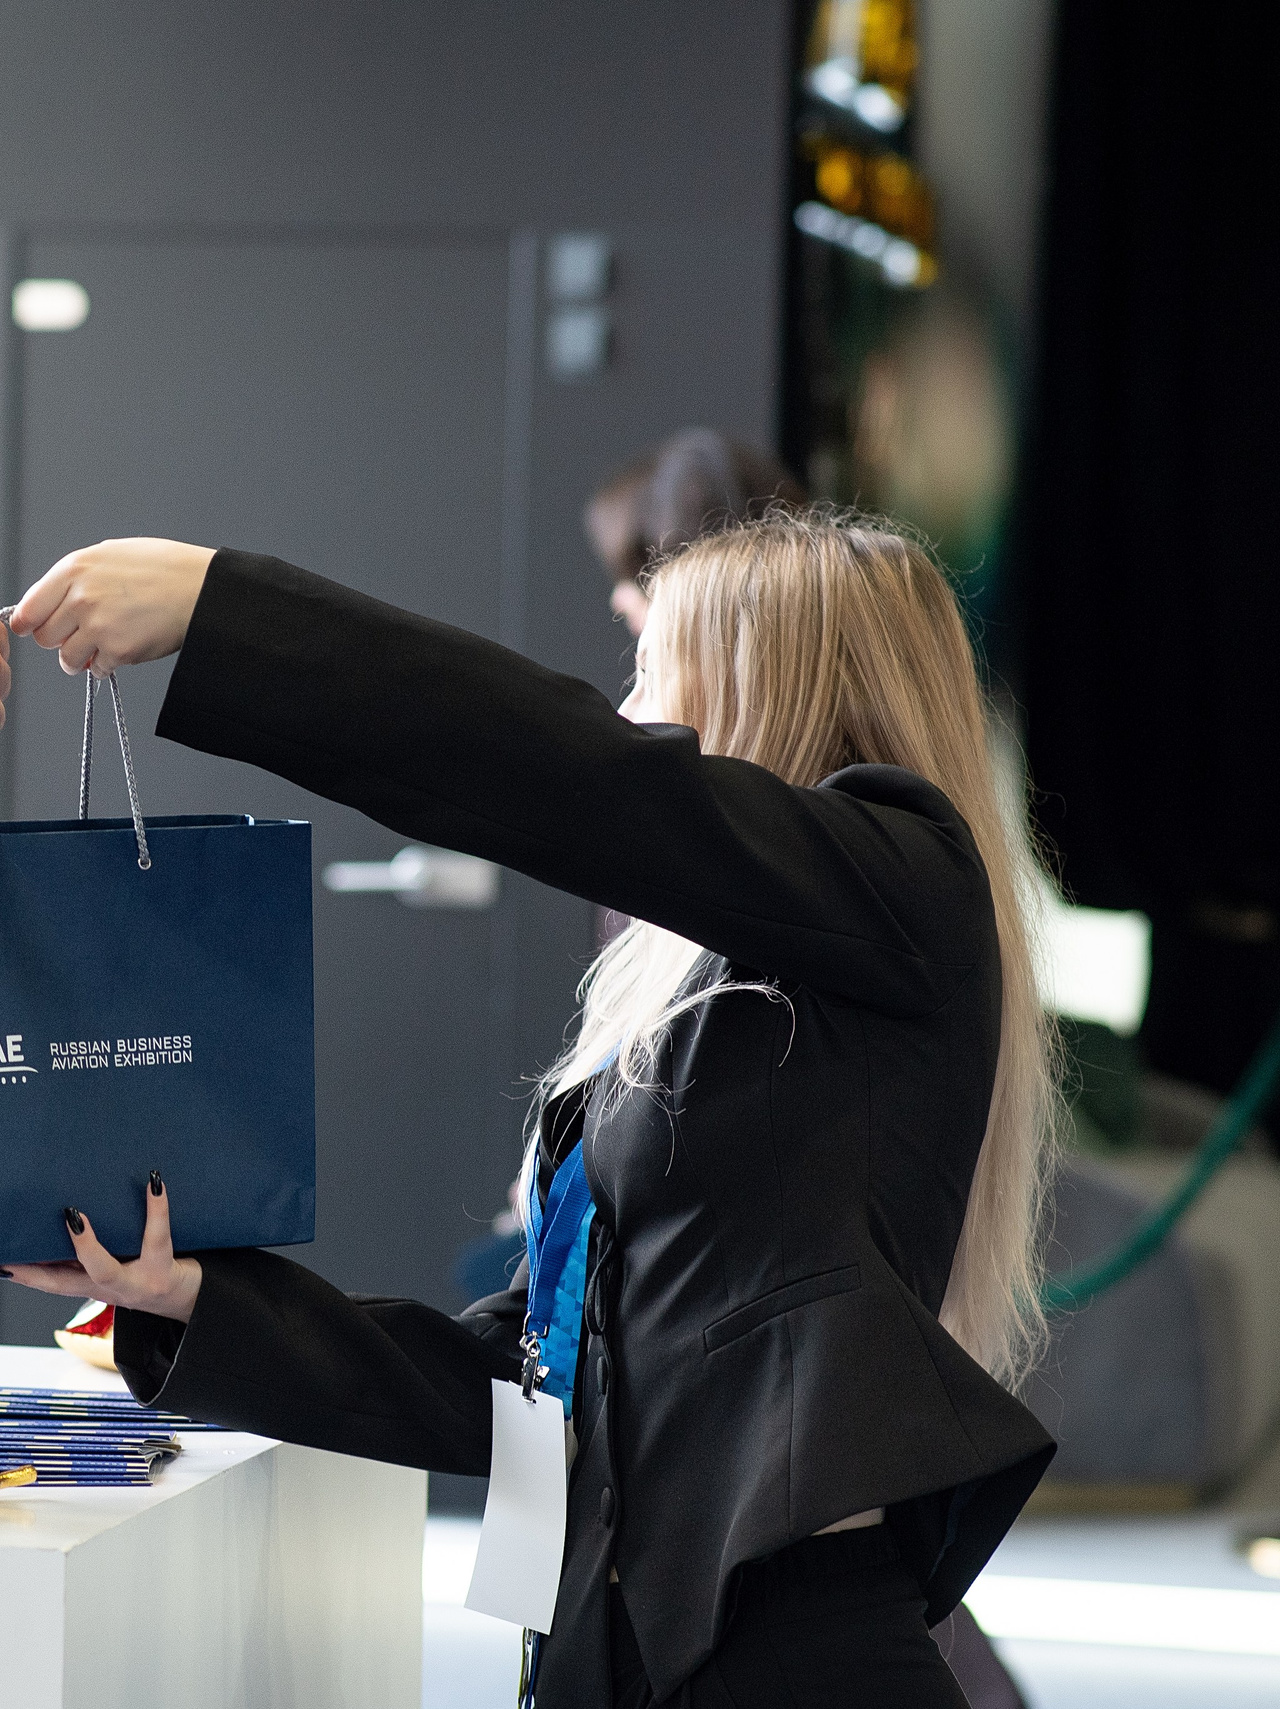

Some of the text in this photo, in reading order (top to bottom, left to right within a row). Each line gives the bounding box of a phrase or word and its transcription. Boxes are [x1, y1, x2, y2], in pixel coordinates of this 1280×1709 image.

[49, 1035, 192, 1056] RUSSIAN BUSINESS
[51, 1049, 193, 1071] AVIATION EXHIBITION
